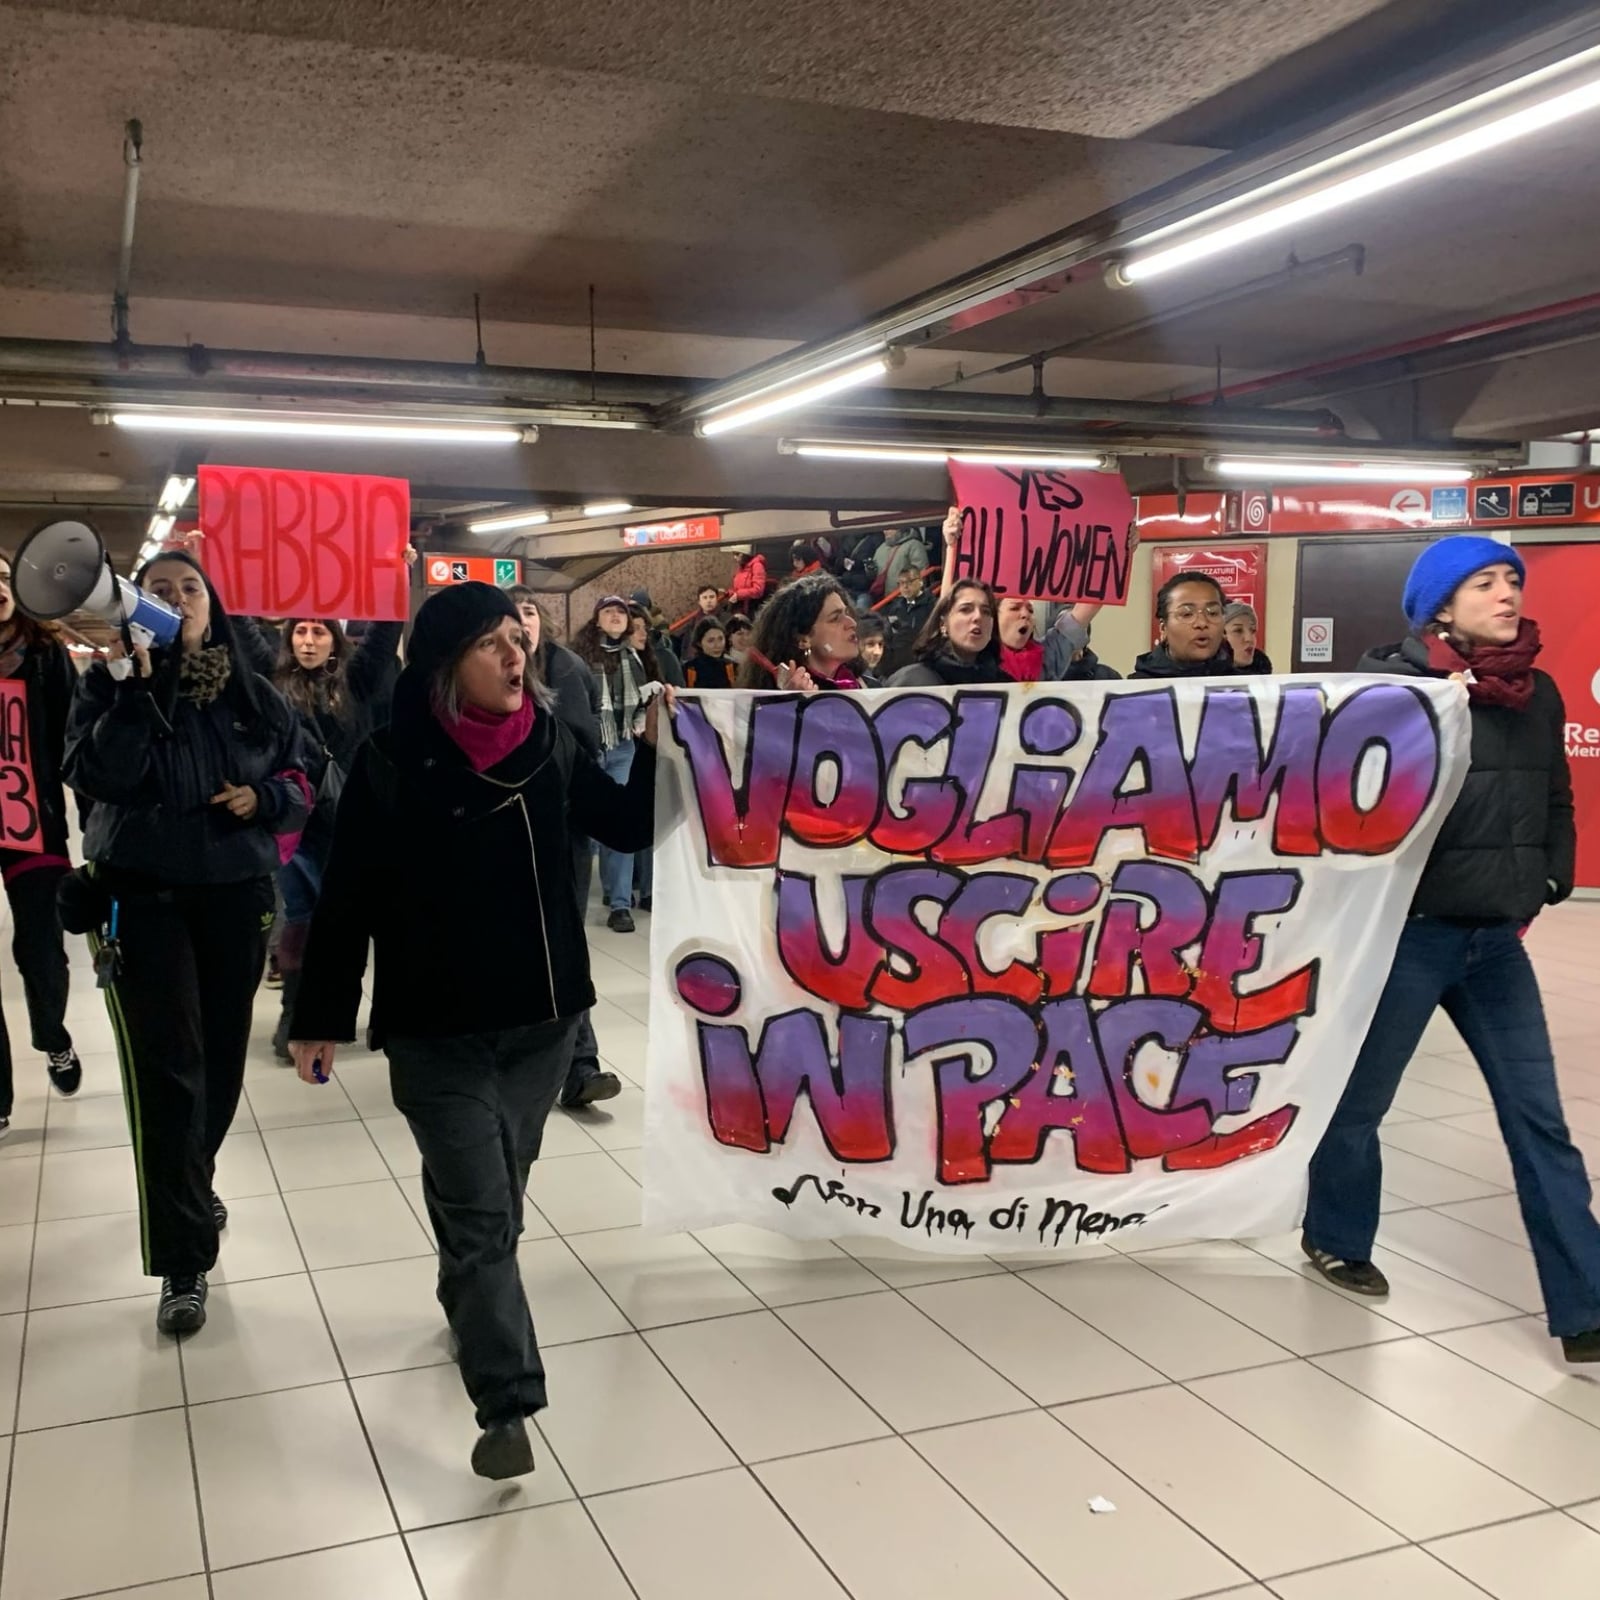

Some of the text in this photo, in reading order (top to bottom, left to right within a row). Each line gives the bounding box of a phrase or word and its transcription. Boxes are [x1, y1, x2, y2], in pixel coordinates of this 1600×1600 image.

[996, 465, 1084, 512] YES
[201, 471, 409, 618] RABBIA
[954, 506, 1132, 600] ALL WOMEN
[0, 766, 38, 842] 3
[903, 998, 1300, 1185] PACE
[902, 1190, 976, 1236] Una
[989, 1197, 1030, 1232] di
